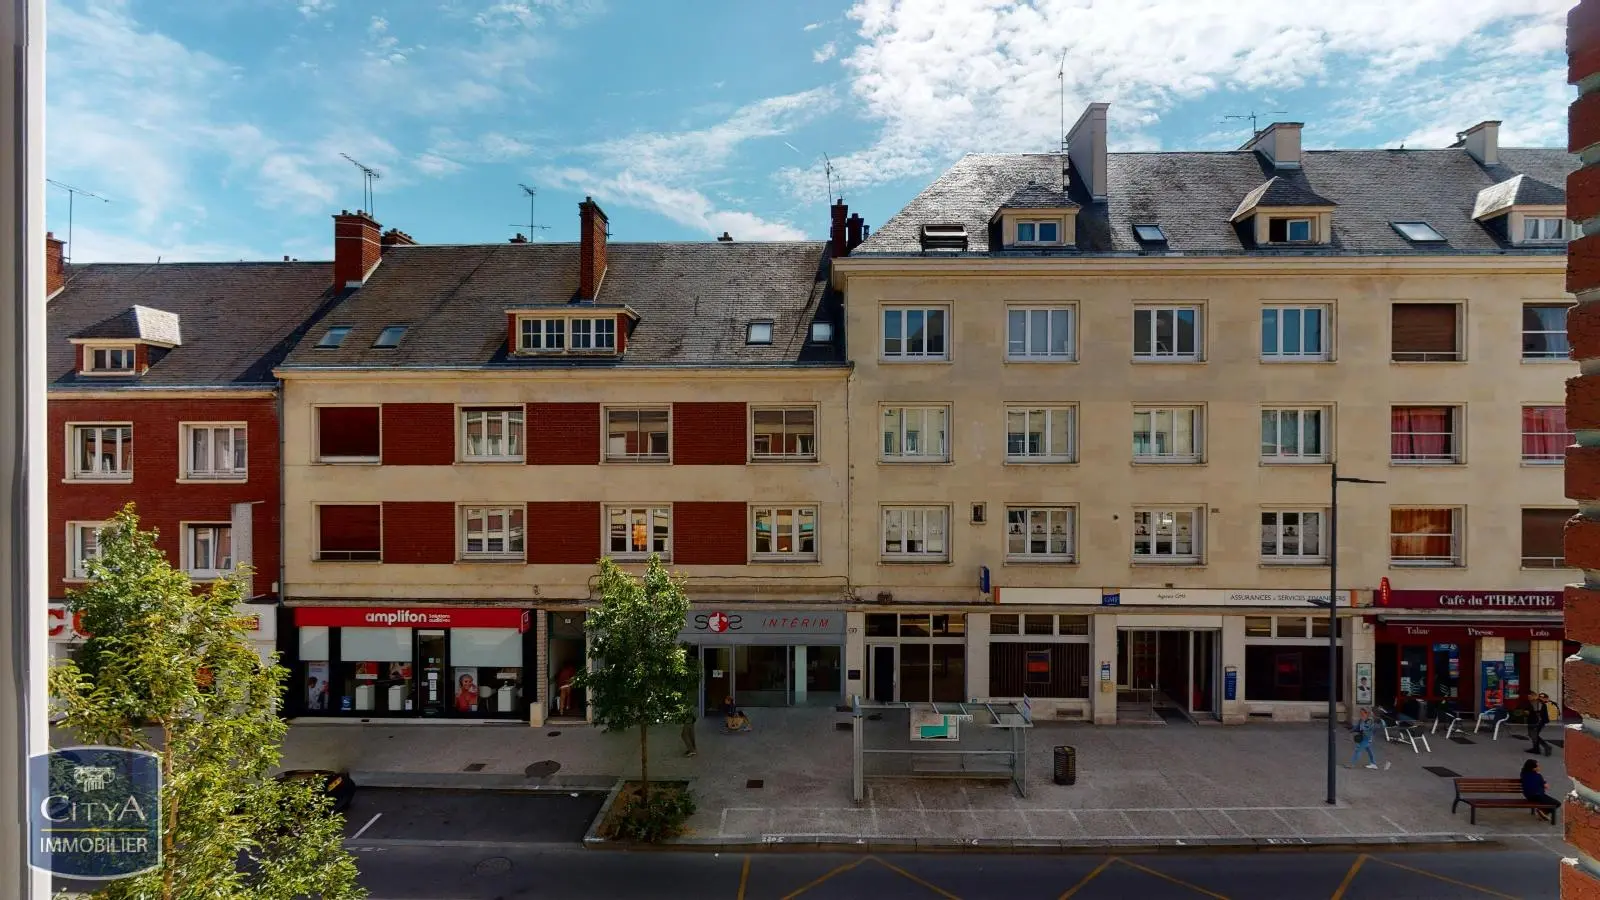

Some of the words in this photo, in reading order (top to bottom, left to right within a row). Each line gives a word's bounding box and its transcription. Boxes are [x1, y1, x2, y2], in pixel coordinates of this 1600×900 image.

[1230, 594, 1271, 602] ASSURANCES
[1278, 594, 1306, 602] SERVICES
[1308, 594, 1346, 602] FINANERS
[1439, 594, 1465, 606] Café
[1468, 595, 1483, 606] du
[1484, 595, 1556, 606] THEATRE
[365, 609, 428, 627] amplifon
[762, 616, 830, 629] INTÉRIM
